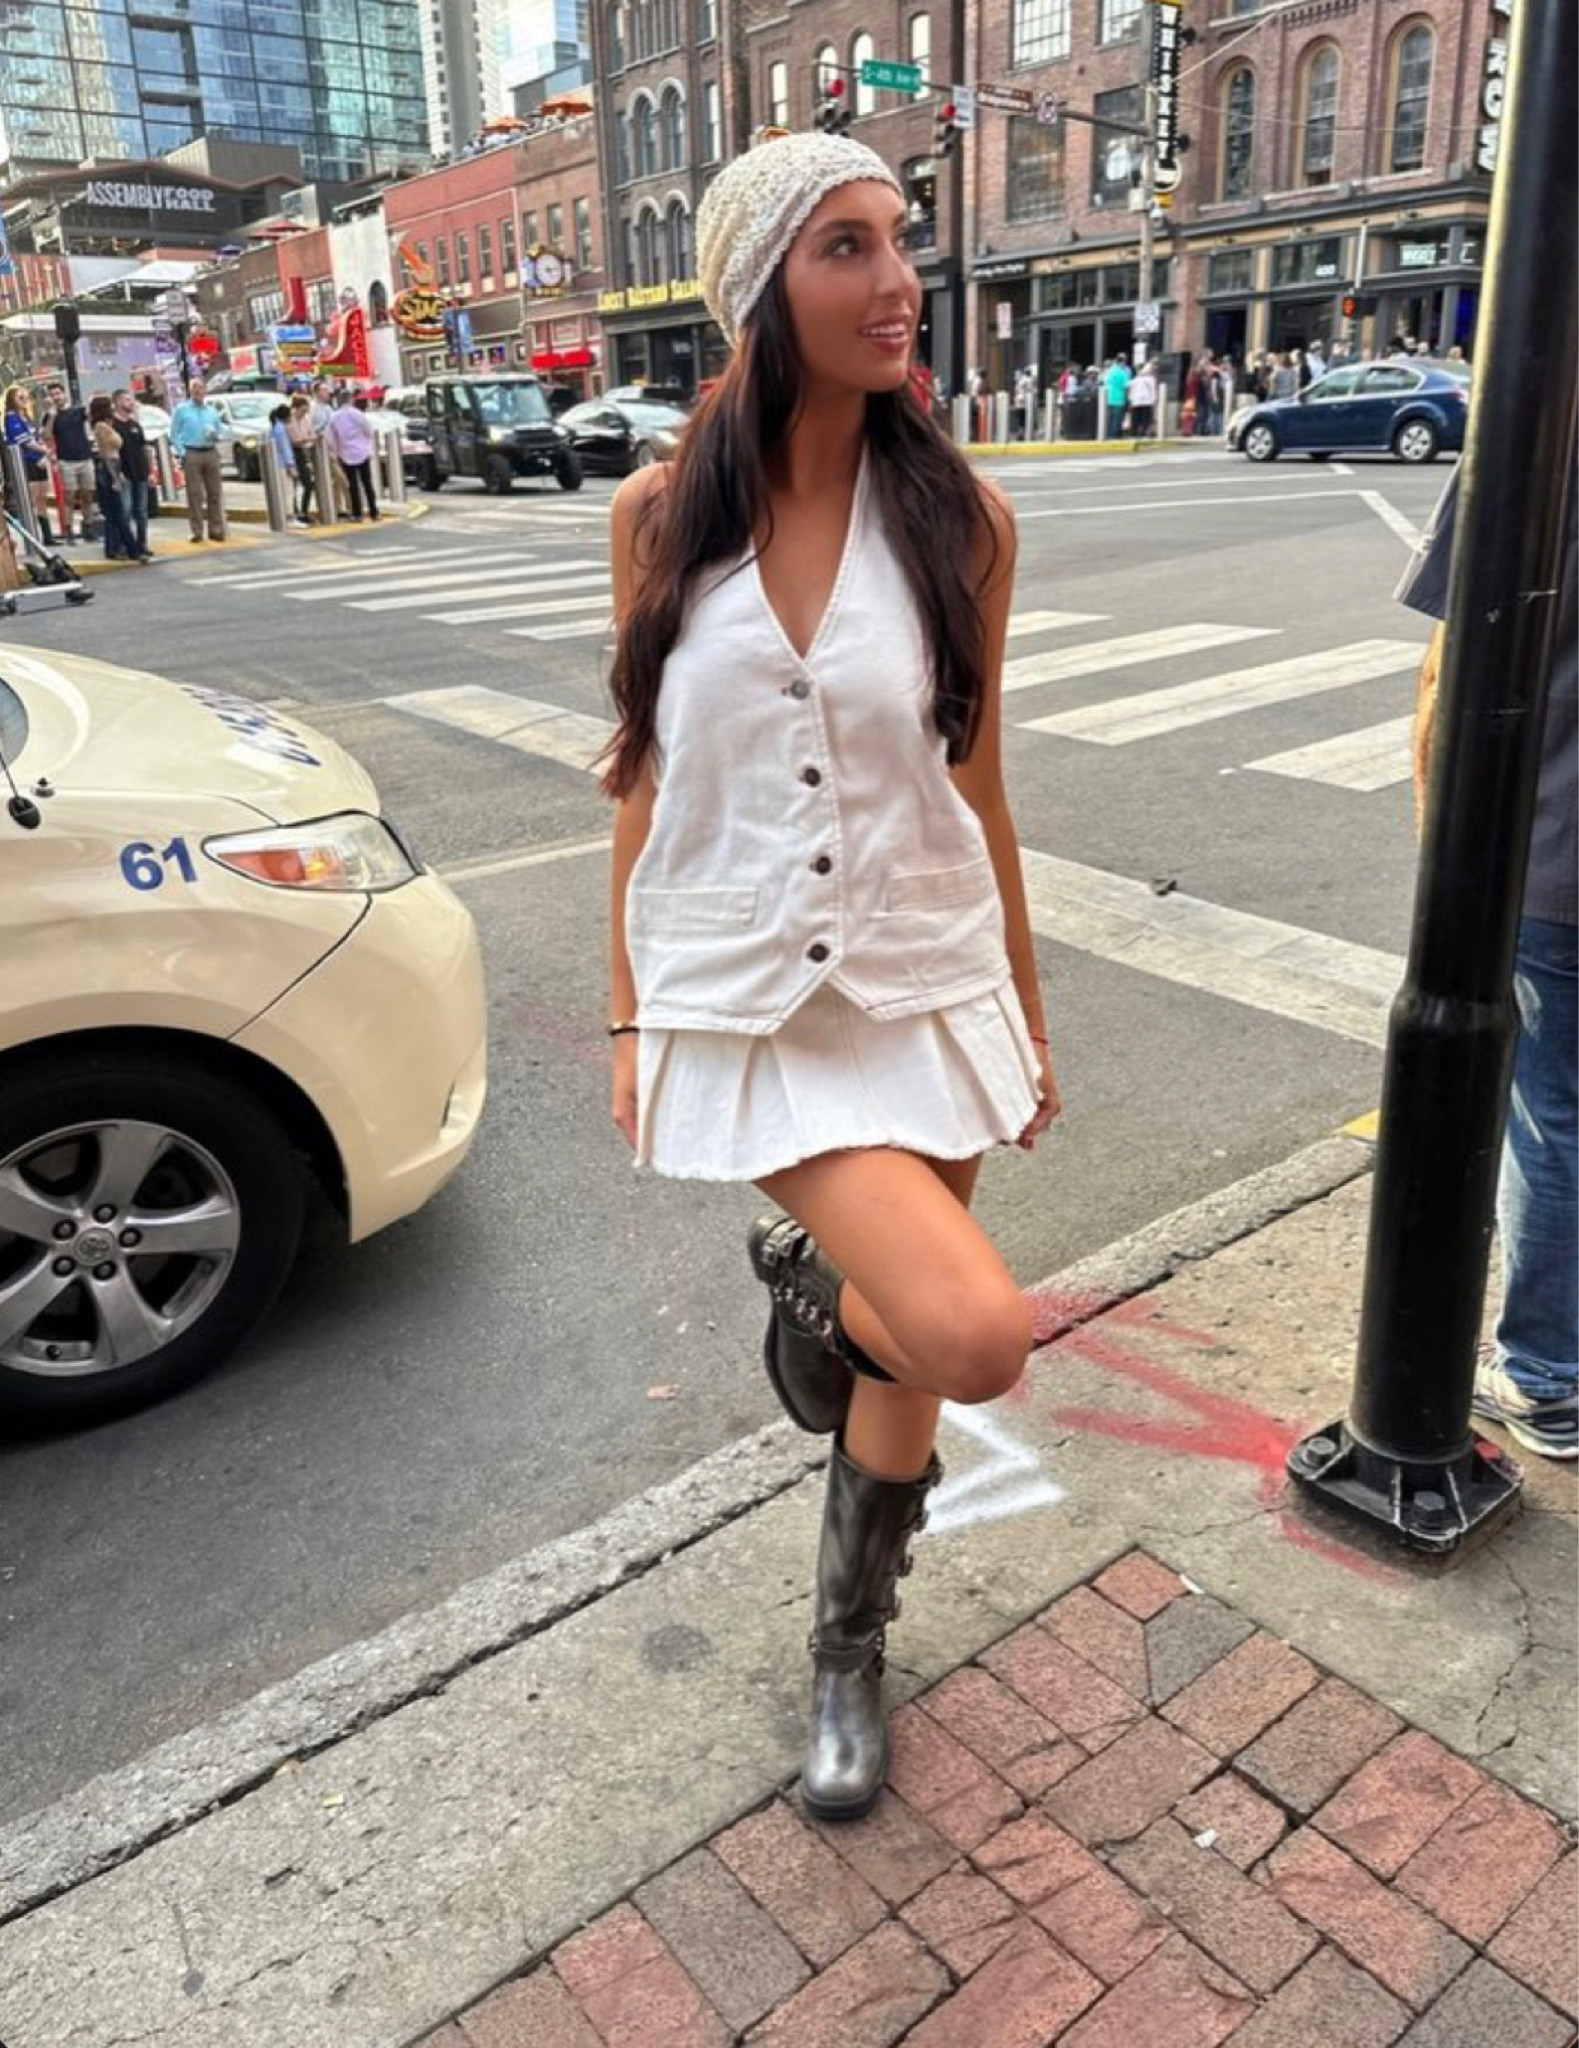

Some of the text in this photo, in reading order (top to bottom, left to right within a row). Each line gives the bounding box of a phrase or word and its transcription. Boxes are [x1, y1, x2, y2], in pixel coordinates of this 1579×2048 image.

[1157, 5, 1178, 159] WHISKEY
[86, 181, 162, 209] ASSEMBLY
[164, 187, 214, 201] FOOD
[164, 198, 217, 213] HALL
[119, 835, 198, 891] 61
